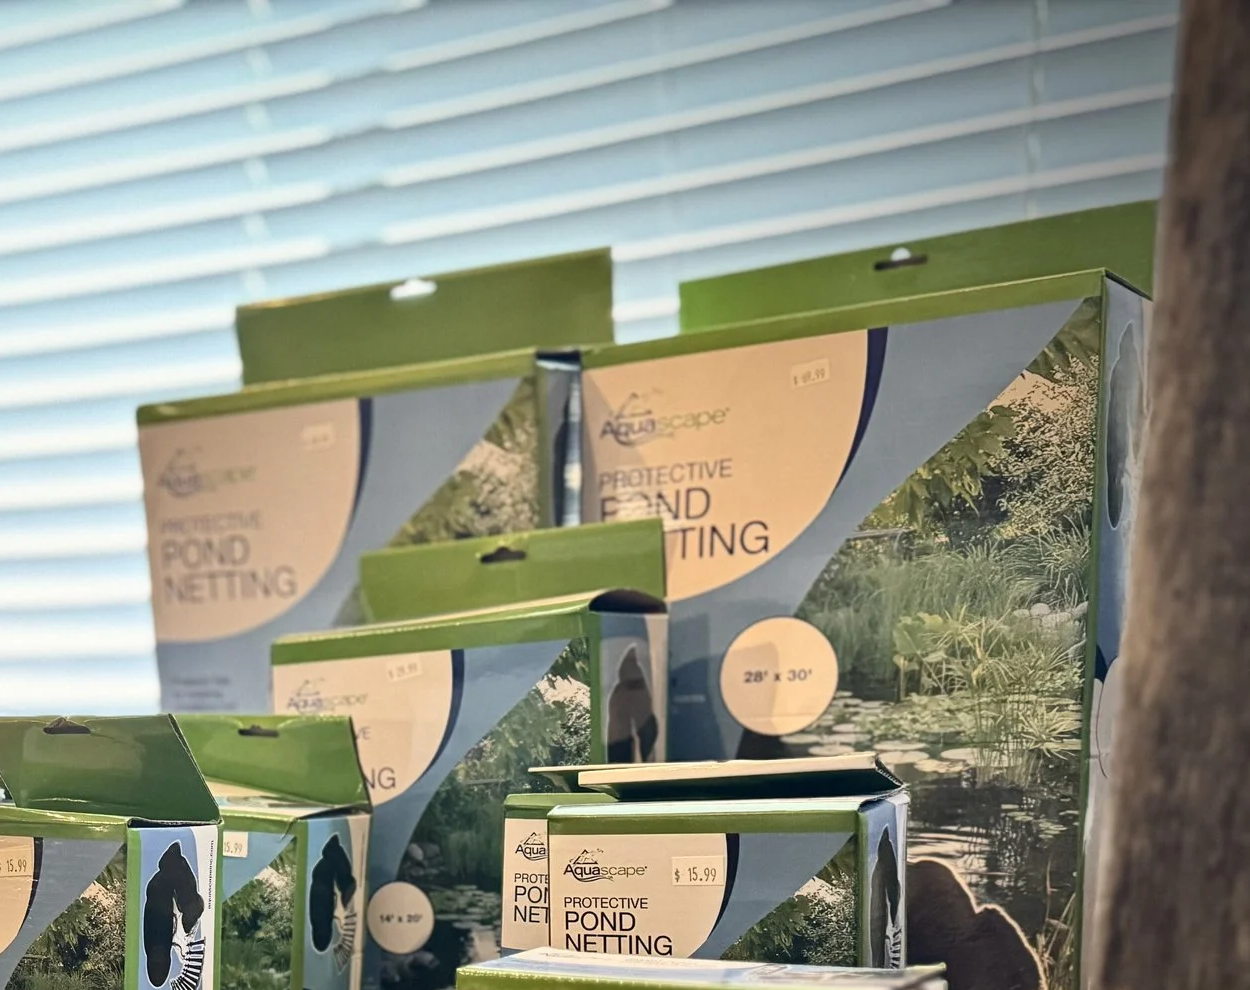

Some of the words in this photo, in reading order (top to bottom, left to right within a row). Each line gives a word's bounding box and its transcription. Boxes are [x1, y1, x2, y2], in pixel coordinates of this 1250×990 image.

[600, 408, 730, 440] Aquascape
[599, 458, 733, 490] PROTECTIVE
[663, 520, 769, 559] TING
[161, 534, 250, 569] POND
[164, 565, 298, 603] NETTING
[6, 859, 28, 873] 15.99
[563, 864, 648, 878] Aquascape
[687, 867, 717, 882] 15.99
[564, 897, 648, 910] PROTECTIVE
[565, 911, 636, 932] POND
[565, 933, 673, 956] NETTING
